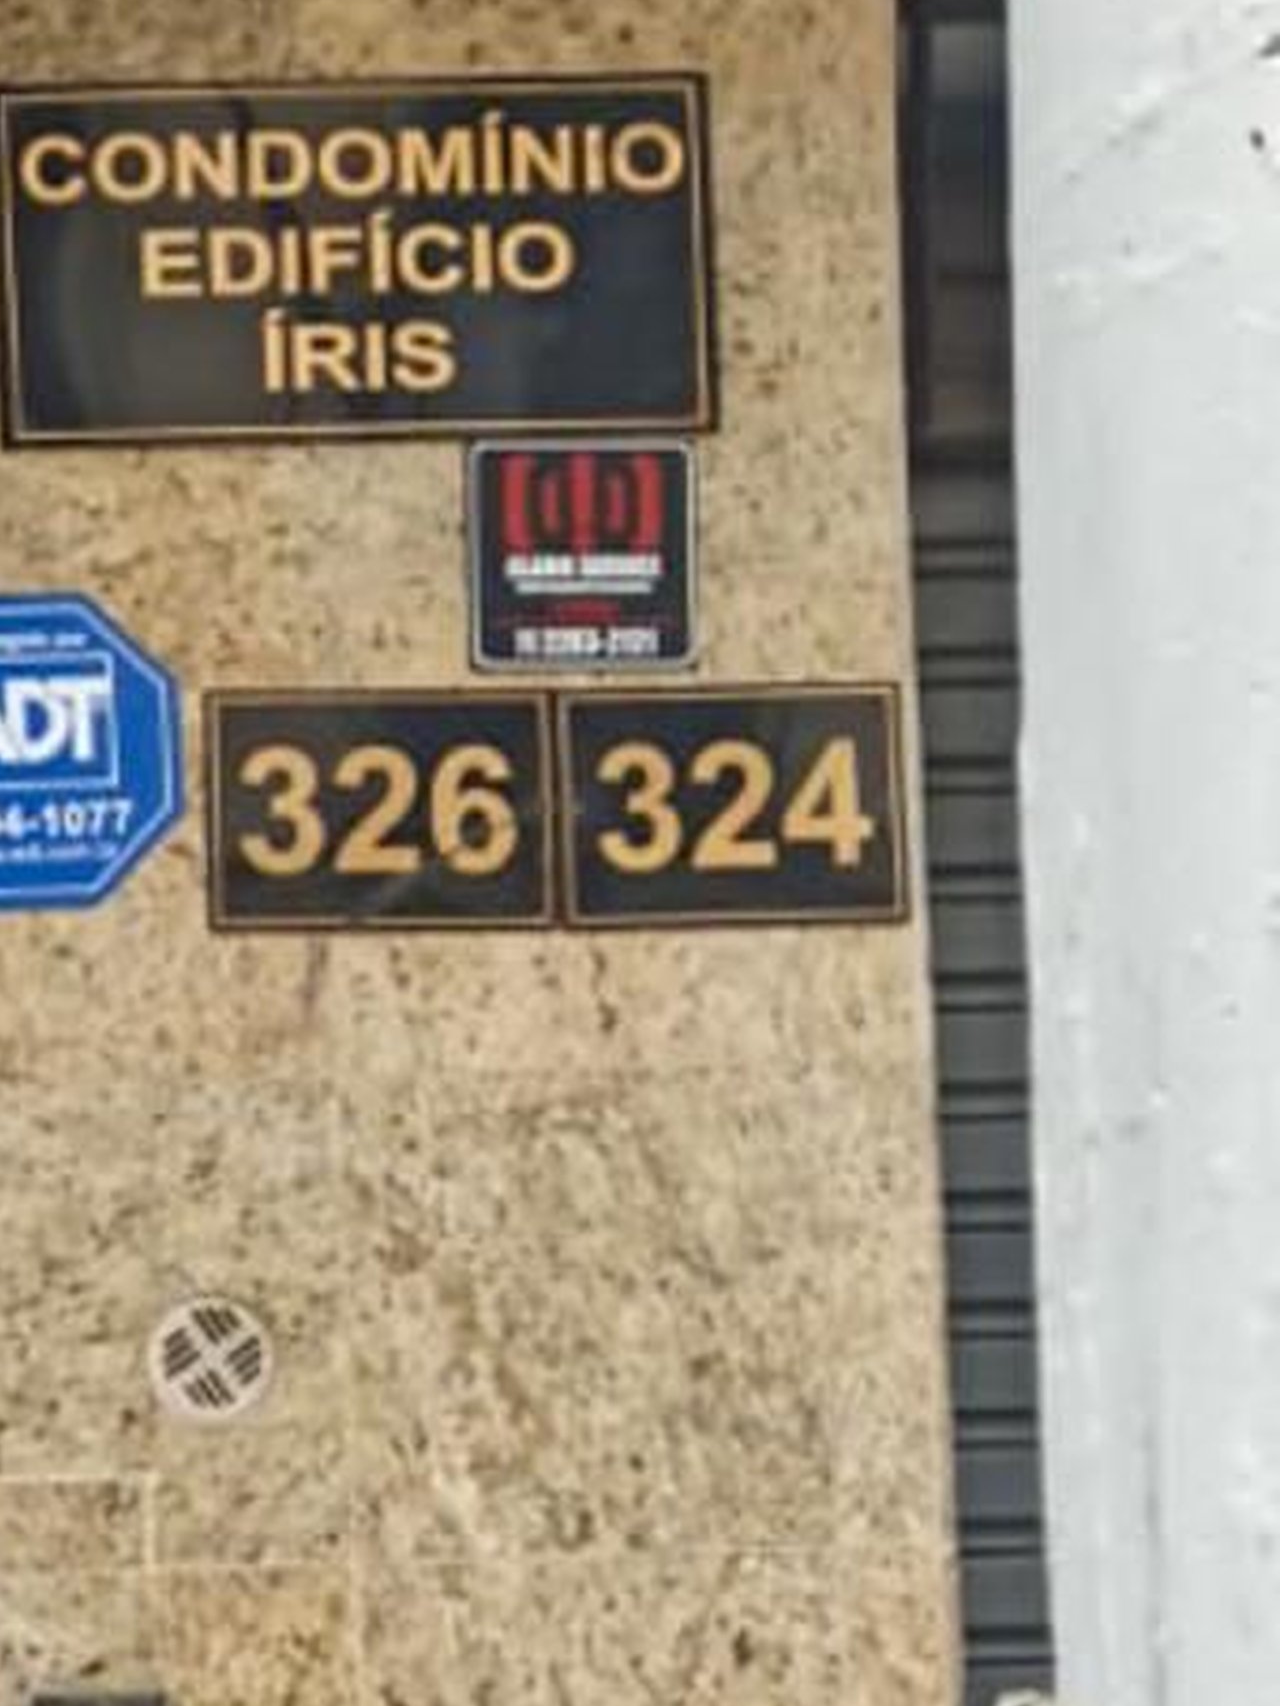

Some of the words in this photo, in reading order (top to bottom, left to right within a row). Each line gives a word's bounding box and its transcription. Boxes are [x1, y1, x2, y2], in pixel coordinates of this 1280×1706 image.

[17, 110, 685, 203] CONDOMÍNIO
[138, 208, 574, 299] EDIFÍCIO
[261, 307, 458, 393] ÍRIS
[237, 743, 519, 878] 326
[594, 736, 874, 873] 324
